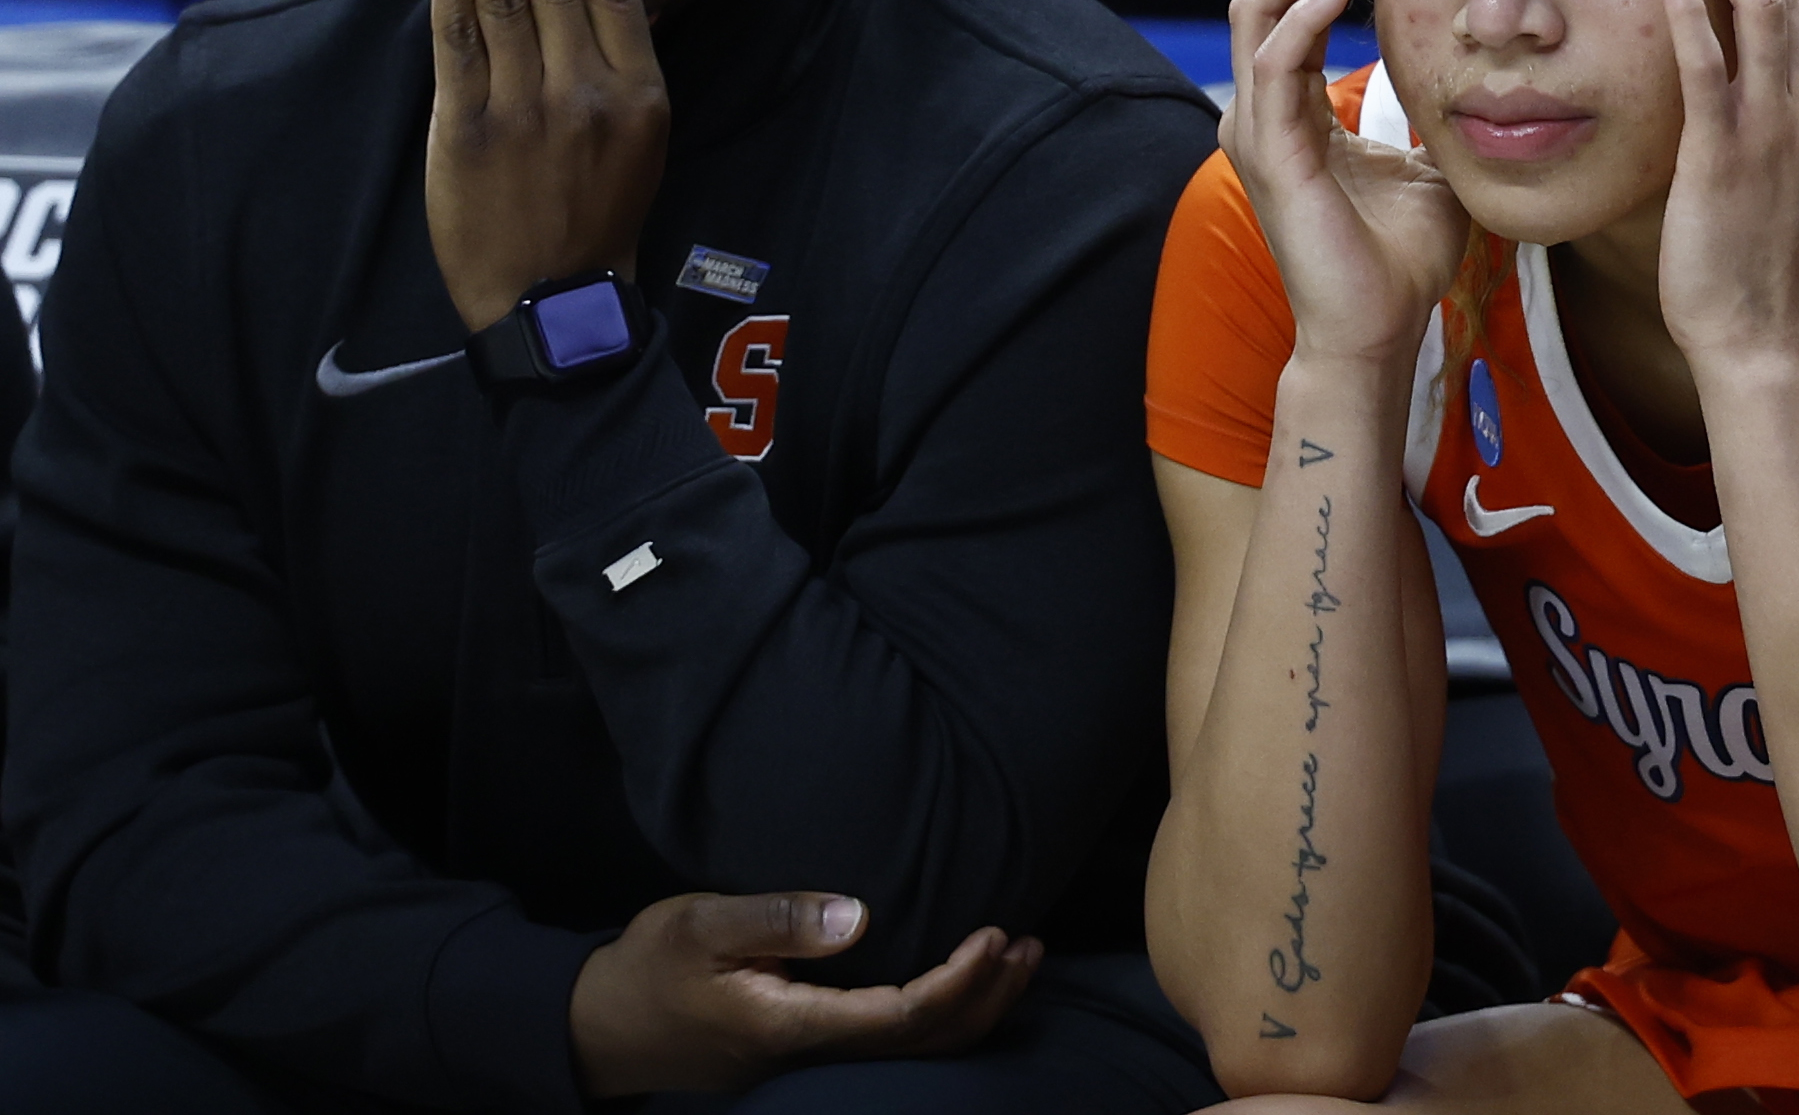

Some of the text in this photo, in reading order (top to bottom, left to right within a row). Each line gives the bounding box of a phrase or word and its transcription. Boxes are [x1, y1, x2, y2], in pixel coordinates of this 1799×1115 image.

[702, 270, 759, 295] MADNESS
[703, 256, 745, 277] MARCH
[705, 314, 790, 462] S
[1260, 1012, 1297, 1039] V
[1299, 438, 1334, 469] V
